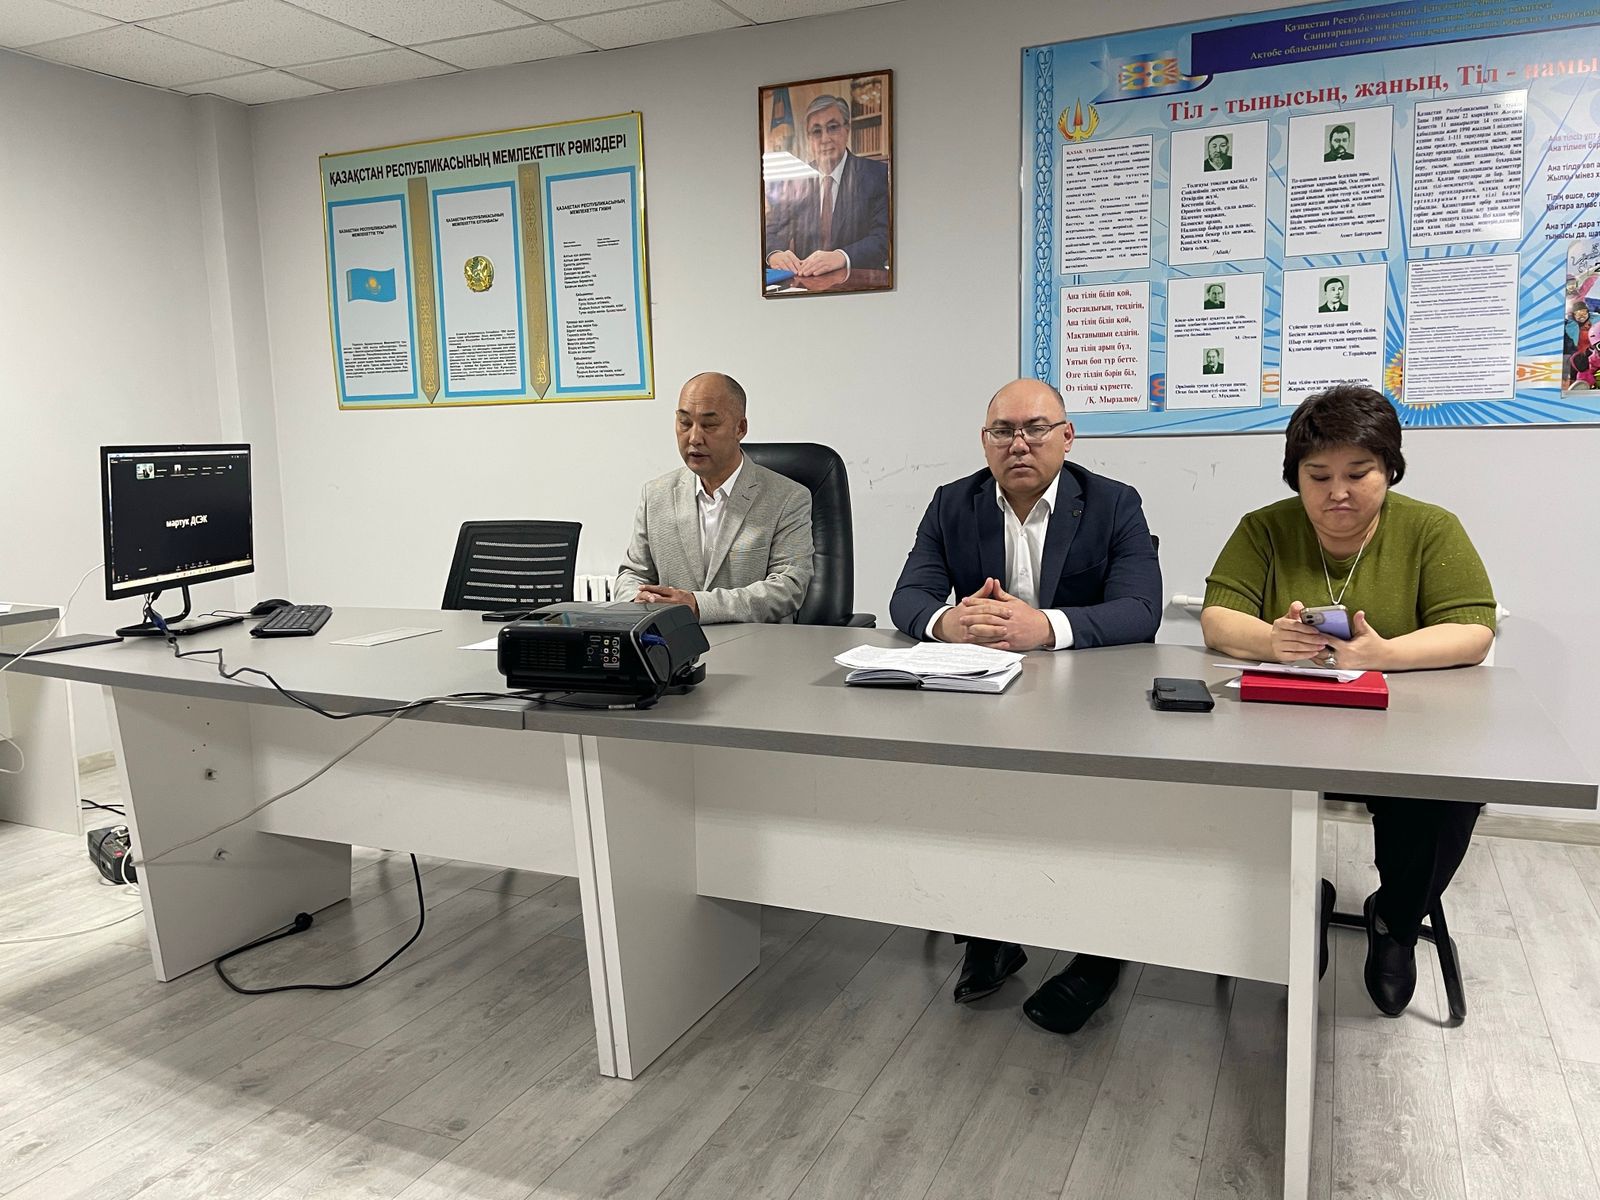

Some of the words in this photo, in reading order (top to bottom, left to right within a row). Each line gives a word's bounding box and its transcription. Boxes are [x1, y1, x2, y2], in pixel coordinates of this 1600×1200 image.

[1167, 102, 1203, 121] Тіл
[1225, 88, 1347, 112] тынысың,
[1355, 75, 1449, 98] жаның,
[1457, 65, 1498, 86] Тіл
[329, 167, 384, 185] ҚАЗАҚСТАН
[385, 153, 491, 177] РЕСПУБЛИКАСЫНЫҢ
[492, 143, 566, 165] МЕМЛЕКЕТТІК
[568, 135, 626, 155] РӘМІЗДЕРІ
[166, 519, 190, 528] мартук
[190, 515, 208, 526] ДСЭК
